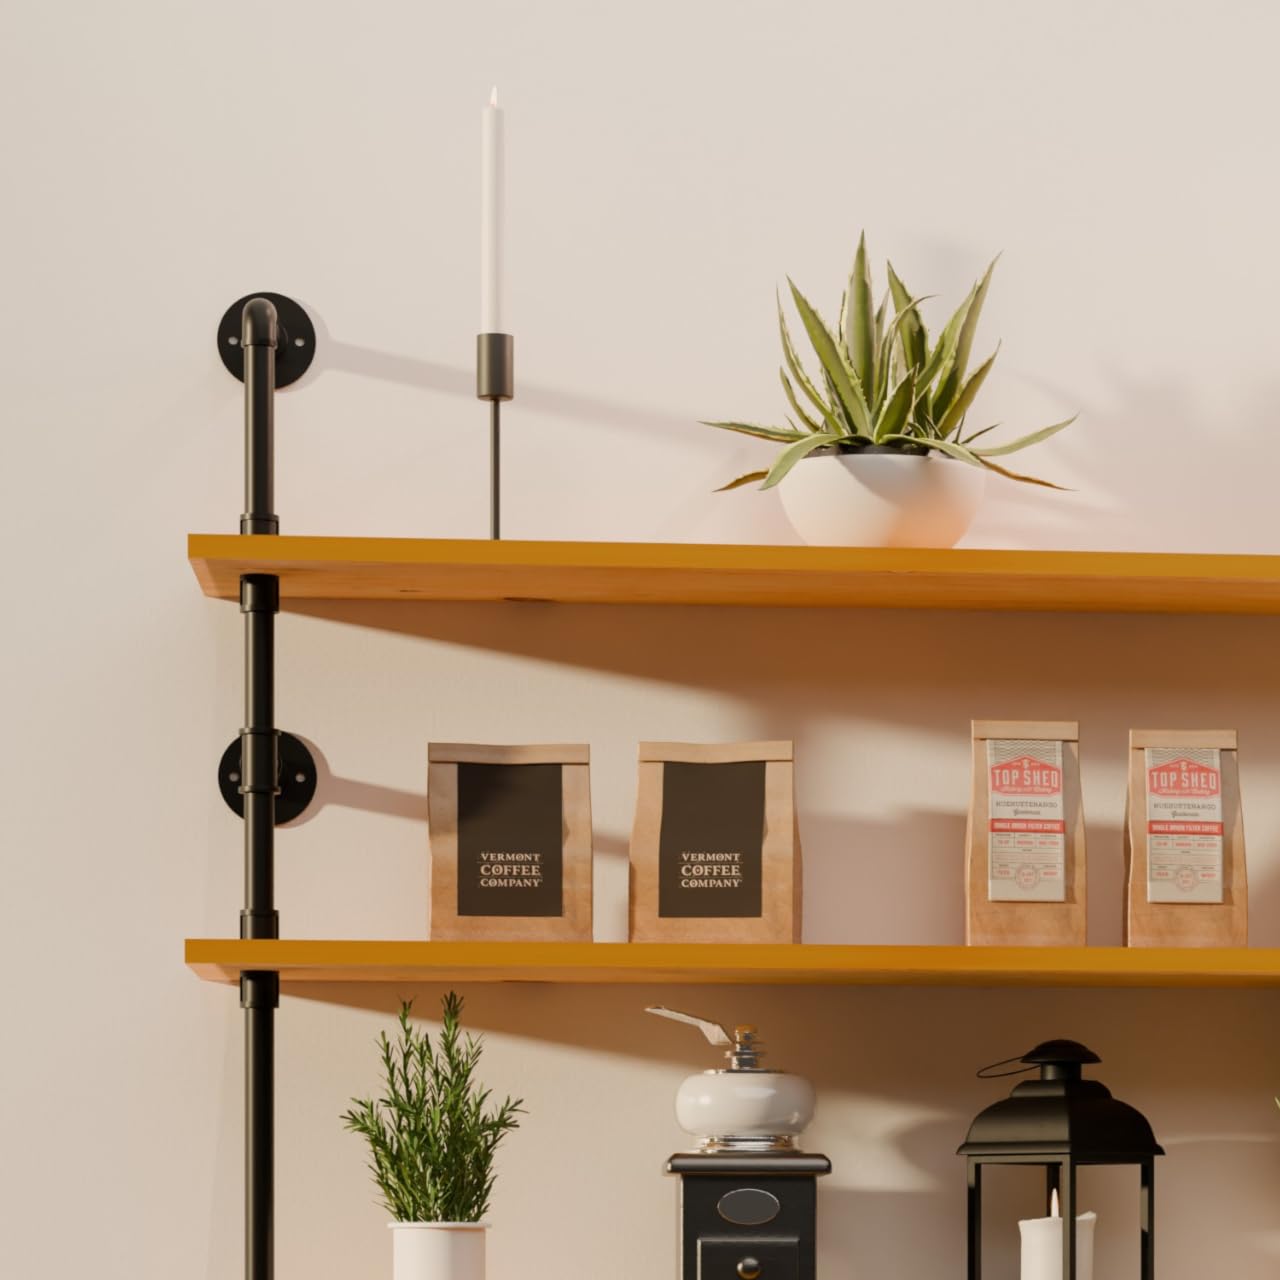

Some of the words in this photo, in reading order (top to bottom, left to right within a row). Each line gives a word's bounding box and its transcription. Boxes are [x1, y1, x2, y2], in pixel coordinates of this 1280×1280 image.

[993, 769, 1019, 787] TOP
[1024, 770, 1059, 788] SHED
[1152, 772, 1177, 790] TOP
[1181, 772, 1217, 790] SHED
[480, 853, 541, 862] VERMONT
[682, 853, 741, 862] VERMONT
[480, 864, 541, 876] COFFEE
[681, 865, 741, 876] COFFEE
[480, 878, 541, 887] COMPANY
[681, 879, 742, 888] COMPANY
